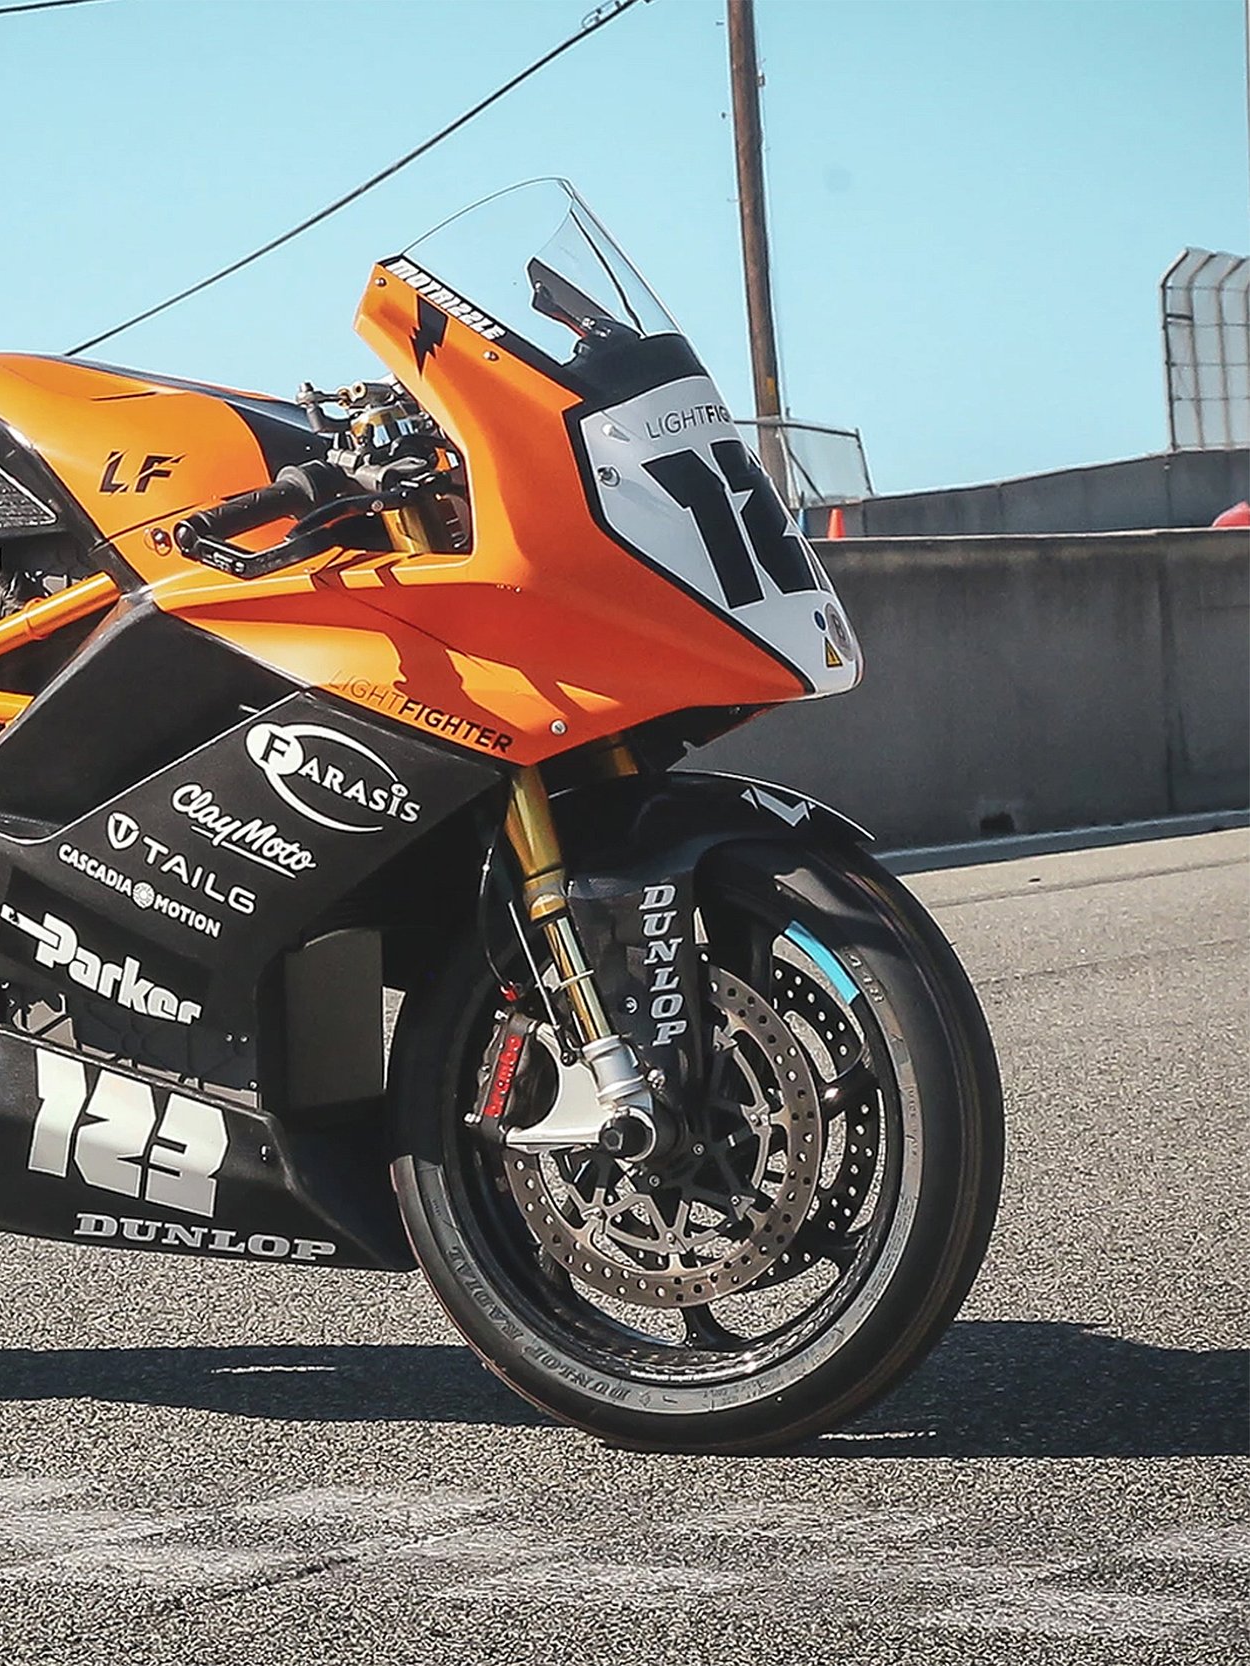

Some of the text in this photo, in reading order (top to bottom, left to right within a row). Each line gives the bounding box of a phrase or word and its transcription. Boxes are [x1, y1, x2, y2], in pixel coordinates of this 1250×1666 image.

[98, 450, 186, 495] LF
[640, 439, 834, 610] 12
[328, 671, 514, 754] LIGHTFIGHTER
[171, 783, 318, 872] ClayMoto
[58, 843, 222, 939] CASCADIA MOTION
[142, 834, 257, 916] TAILG
[30, 911, 203, 1025] Parker
[638, 883, 688, 1047] DUNLOP
[27, 1047, 230, 1219] 123
[73, 1212, 337, 1262] DUNLOP
